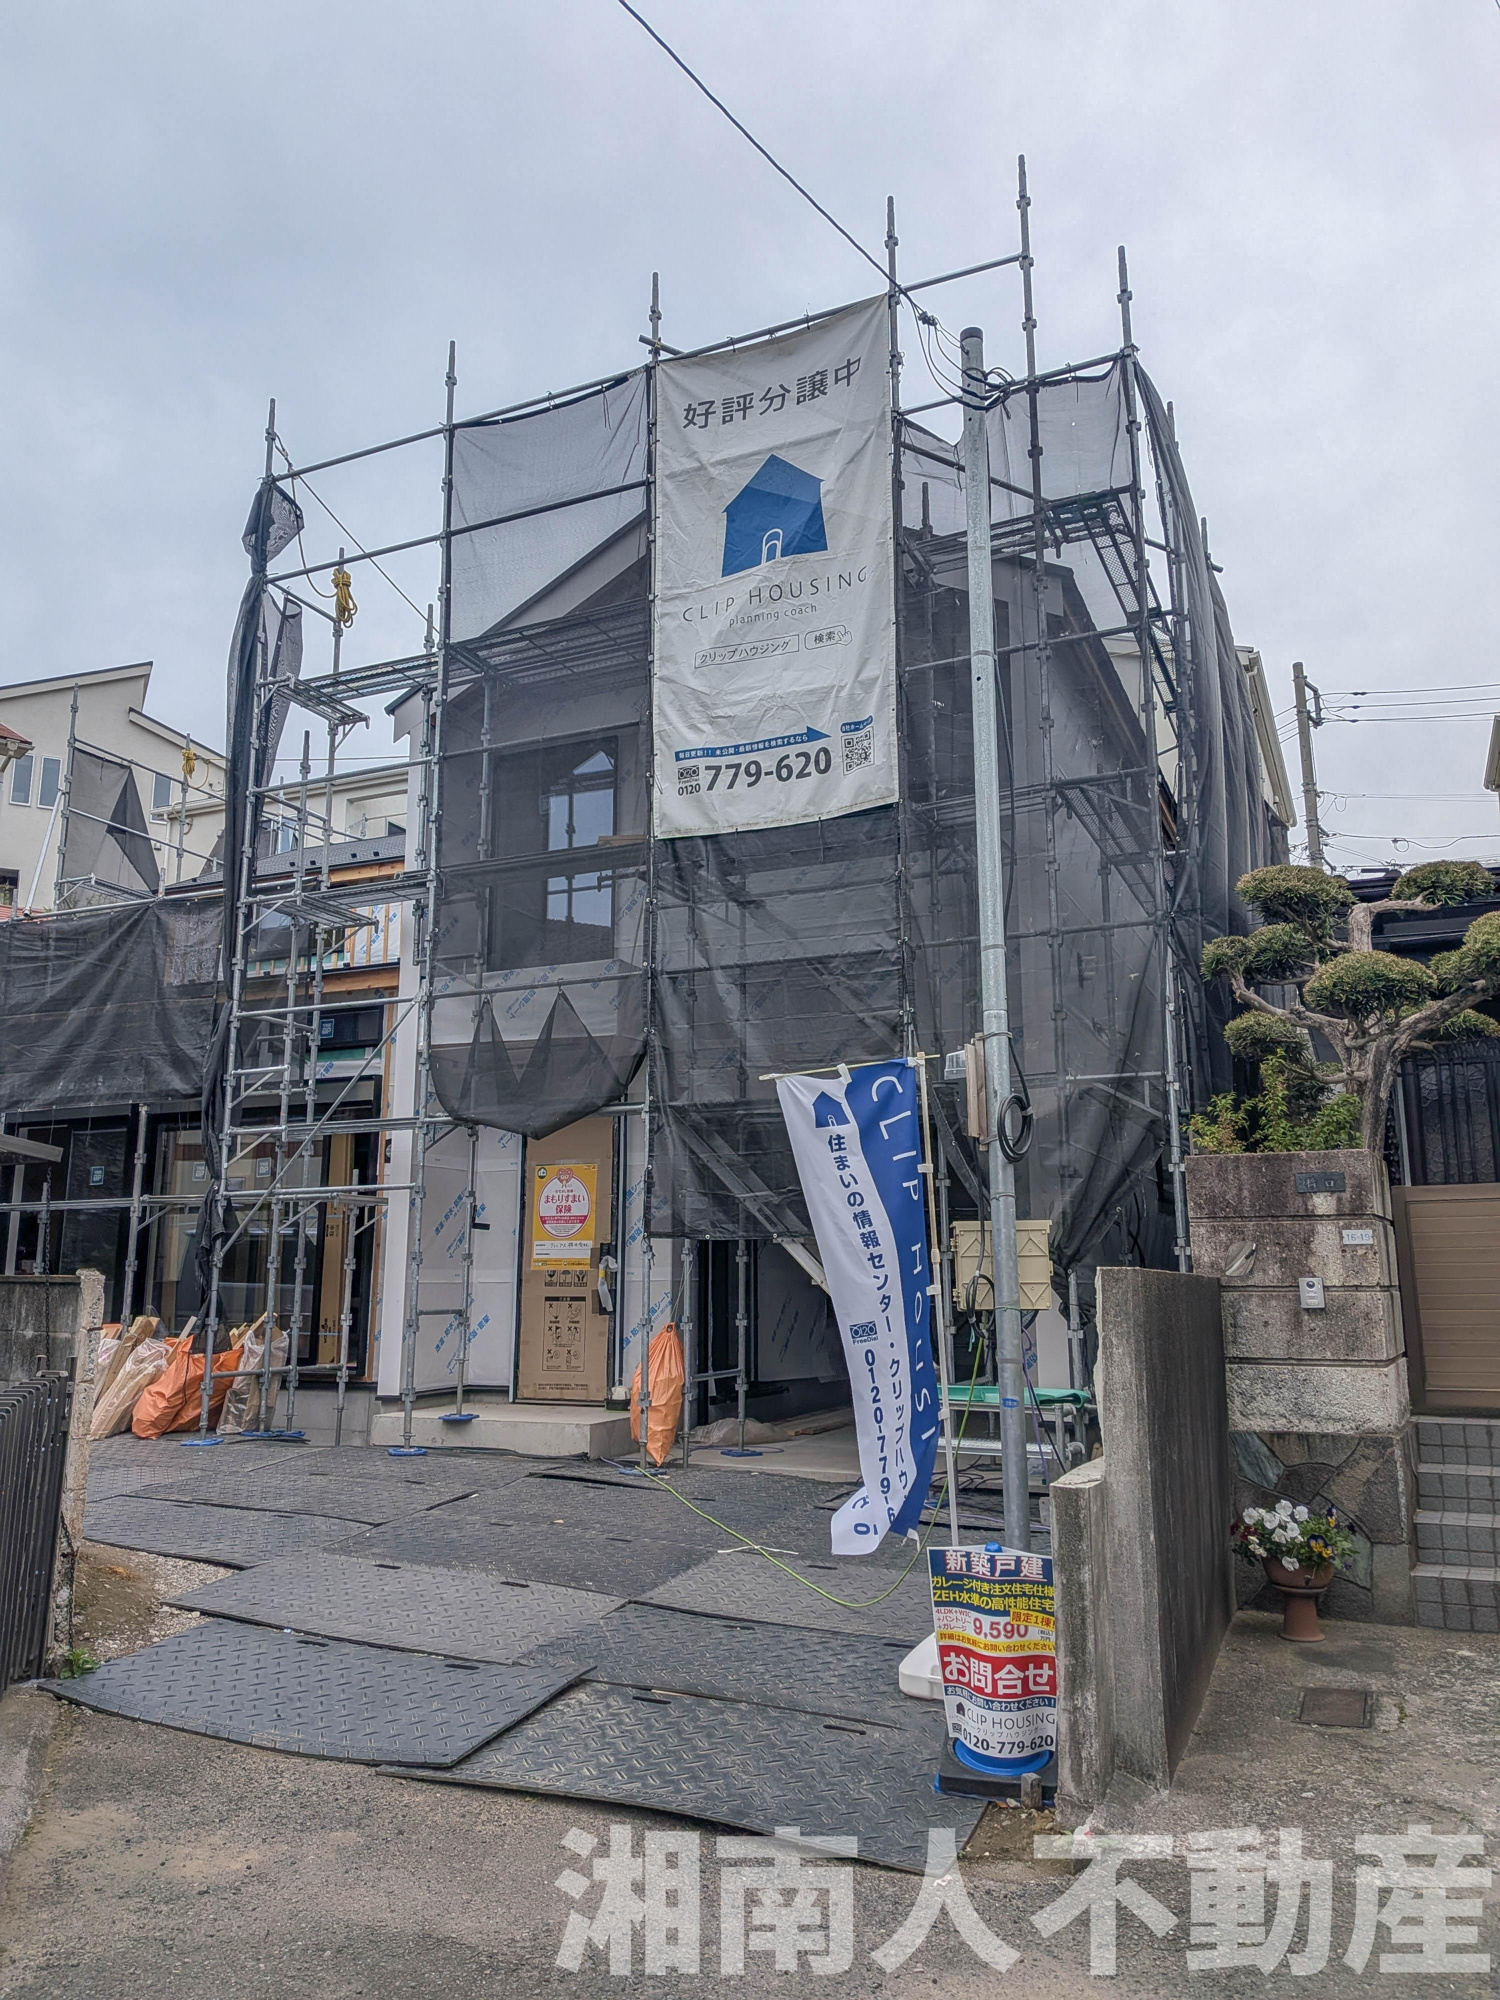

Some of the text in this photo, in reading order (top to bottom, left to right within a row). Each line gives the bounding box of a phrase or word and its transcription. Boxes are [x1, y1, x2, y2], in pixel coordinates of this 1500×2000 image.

[682, 356, 863, 430] 好評分譲中
[682, 566, 868, 622] CLIP HOUSING
[729, 603, 817, 628] planning coach
[699, 631, 837, 664] クリップハウジング 検索
[678, 746, 832, 796] 0120 779-620
[871, 1075, 920, 1201] CLIP
[544, 1193, 586, 1204] まもりすまい
[555, 1204, 573, 1215] 保険
[1346, 1233, 1371, 1242] 16-19
[827, 1133, 909, 1498] 住まいの情報センター・クリップハウ
[852, 1335, 879, 1345] FreeDial
[945, 1549, 1044, 1579] 新築戸建
[931, 1576, 1055, 1597] ガレージ付き注文住宅仕様
[933, 1590, 1055, 1612] ZEH水準の高性能住宅
[972, 1617, 1029, 1640] 9,590
[943, 1652, 1054, 1695] お問合せ
[966, 1708, 987, 1726] CLIP
[991, 1712, 1056, 1730] HOUSING
[962, 1734, 1054, 1755] 0120-779-620
